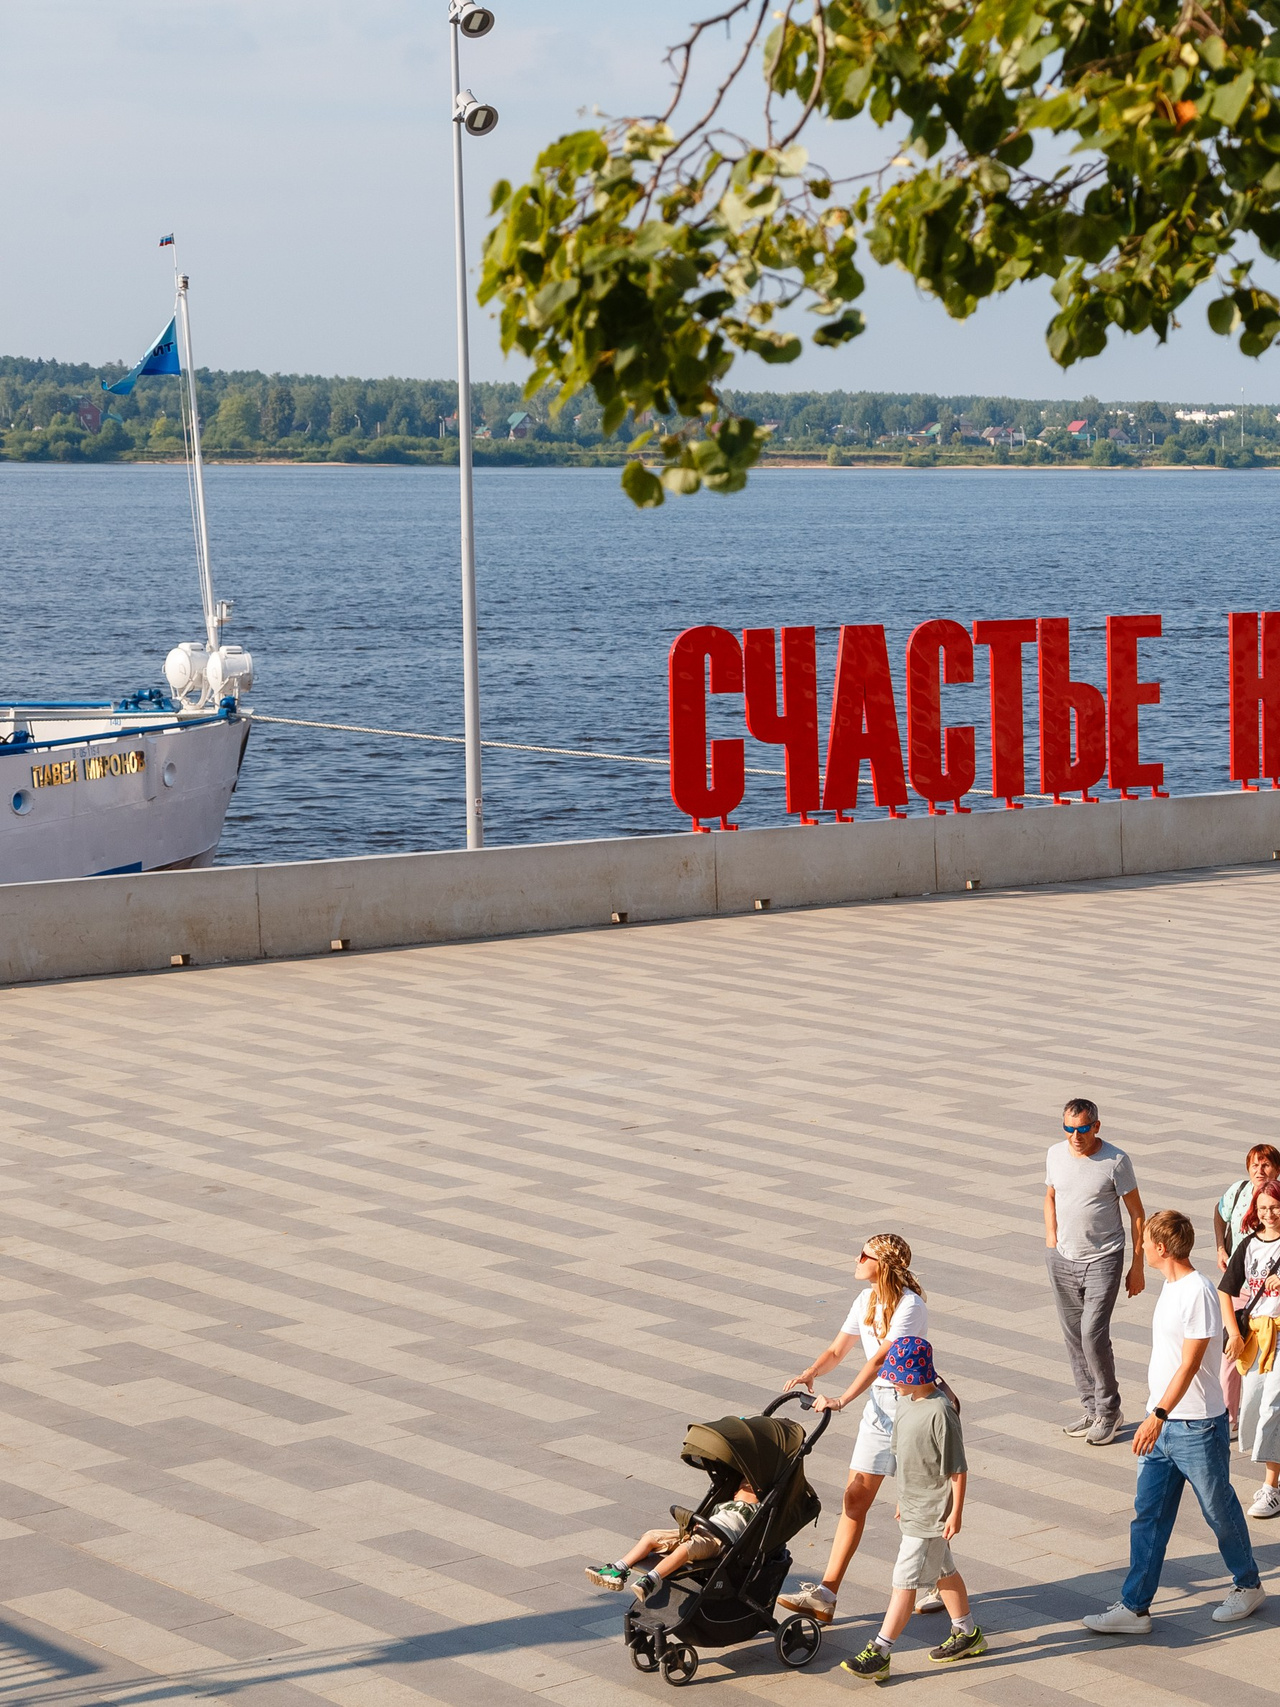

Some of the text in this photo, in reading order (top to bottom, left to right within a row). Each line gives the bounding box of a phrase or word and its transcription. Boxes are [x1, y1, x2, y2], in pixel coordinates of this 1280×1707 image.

[31, 751, 145, 788] ПАВЕЛ МИРОНОВ
[669, 614, 1164, 818] СЧАСТЬЕ
